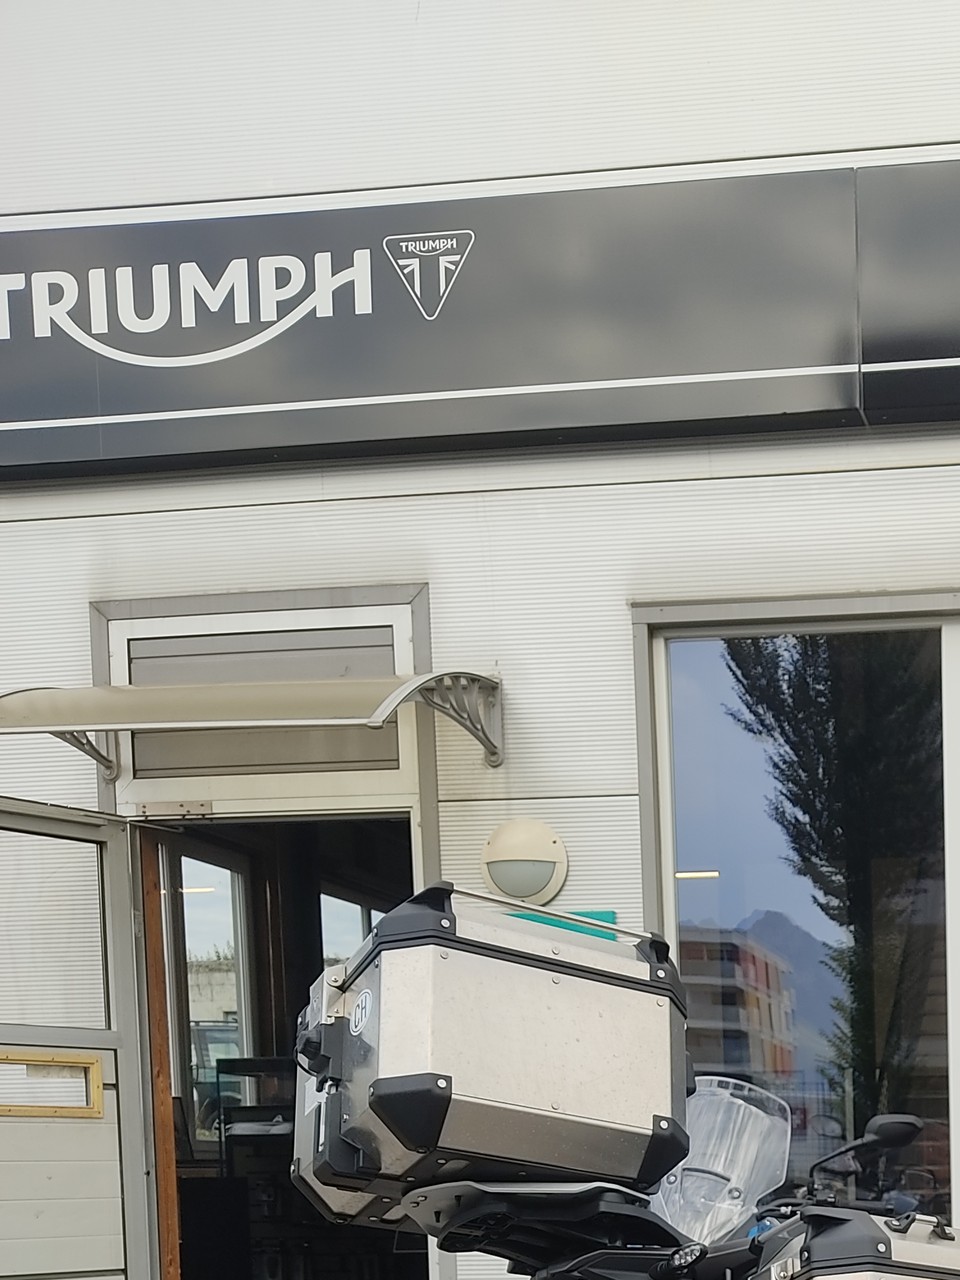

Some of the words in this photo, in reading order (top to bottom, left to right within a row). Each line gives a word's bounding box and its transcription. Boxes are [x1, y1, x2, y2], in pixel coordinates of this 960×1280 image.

[399, 237, 457, 256] TRIUMPH
[0, 249, 373, 367] TRIUMPH
[354, 994, 367, 1029] CH
